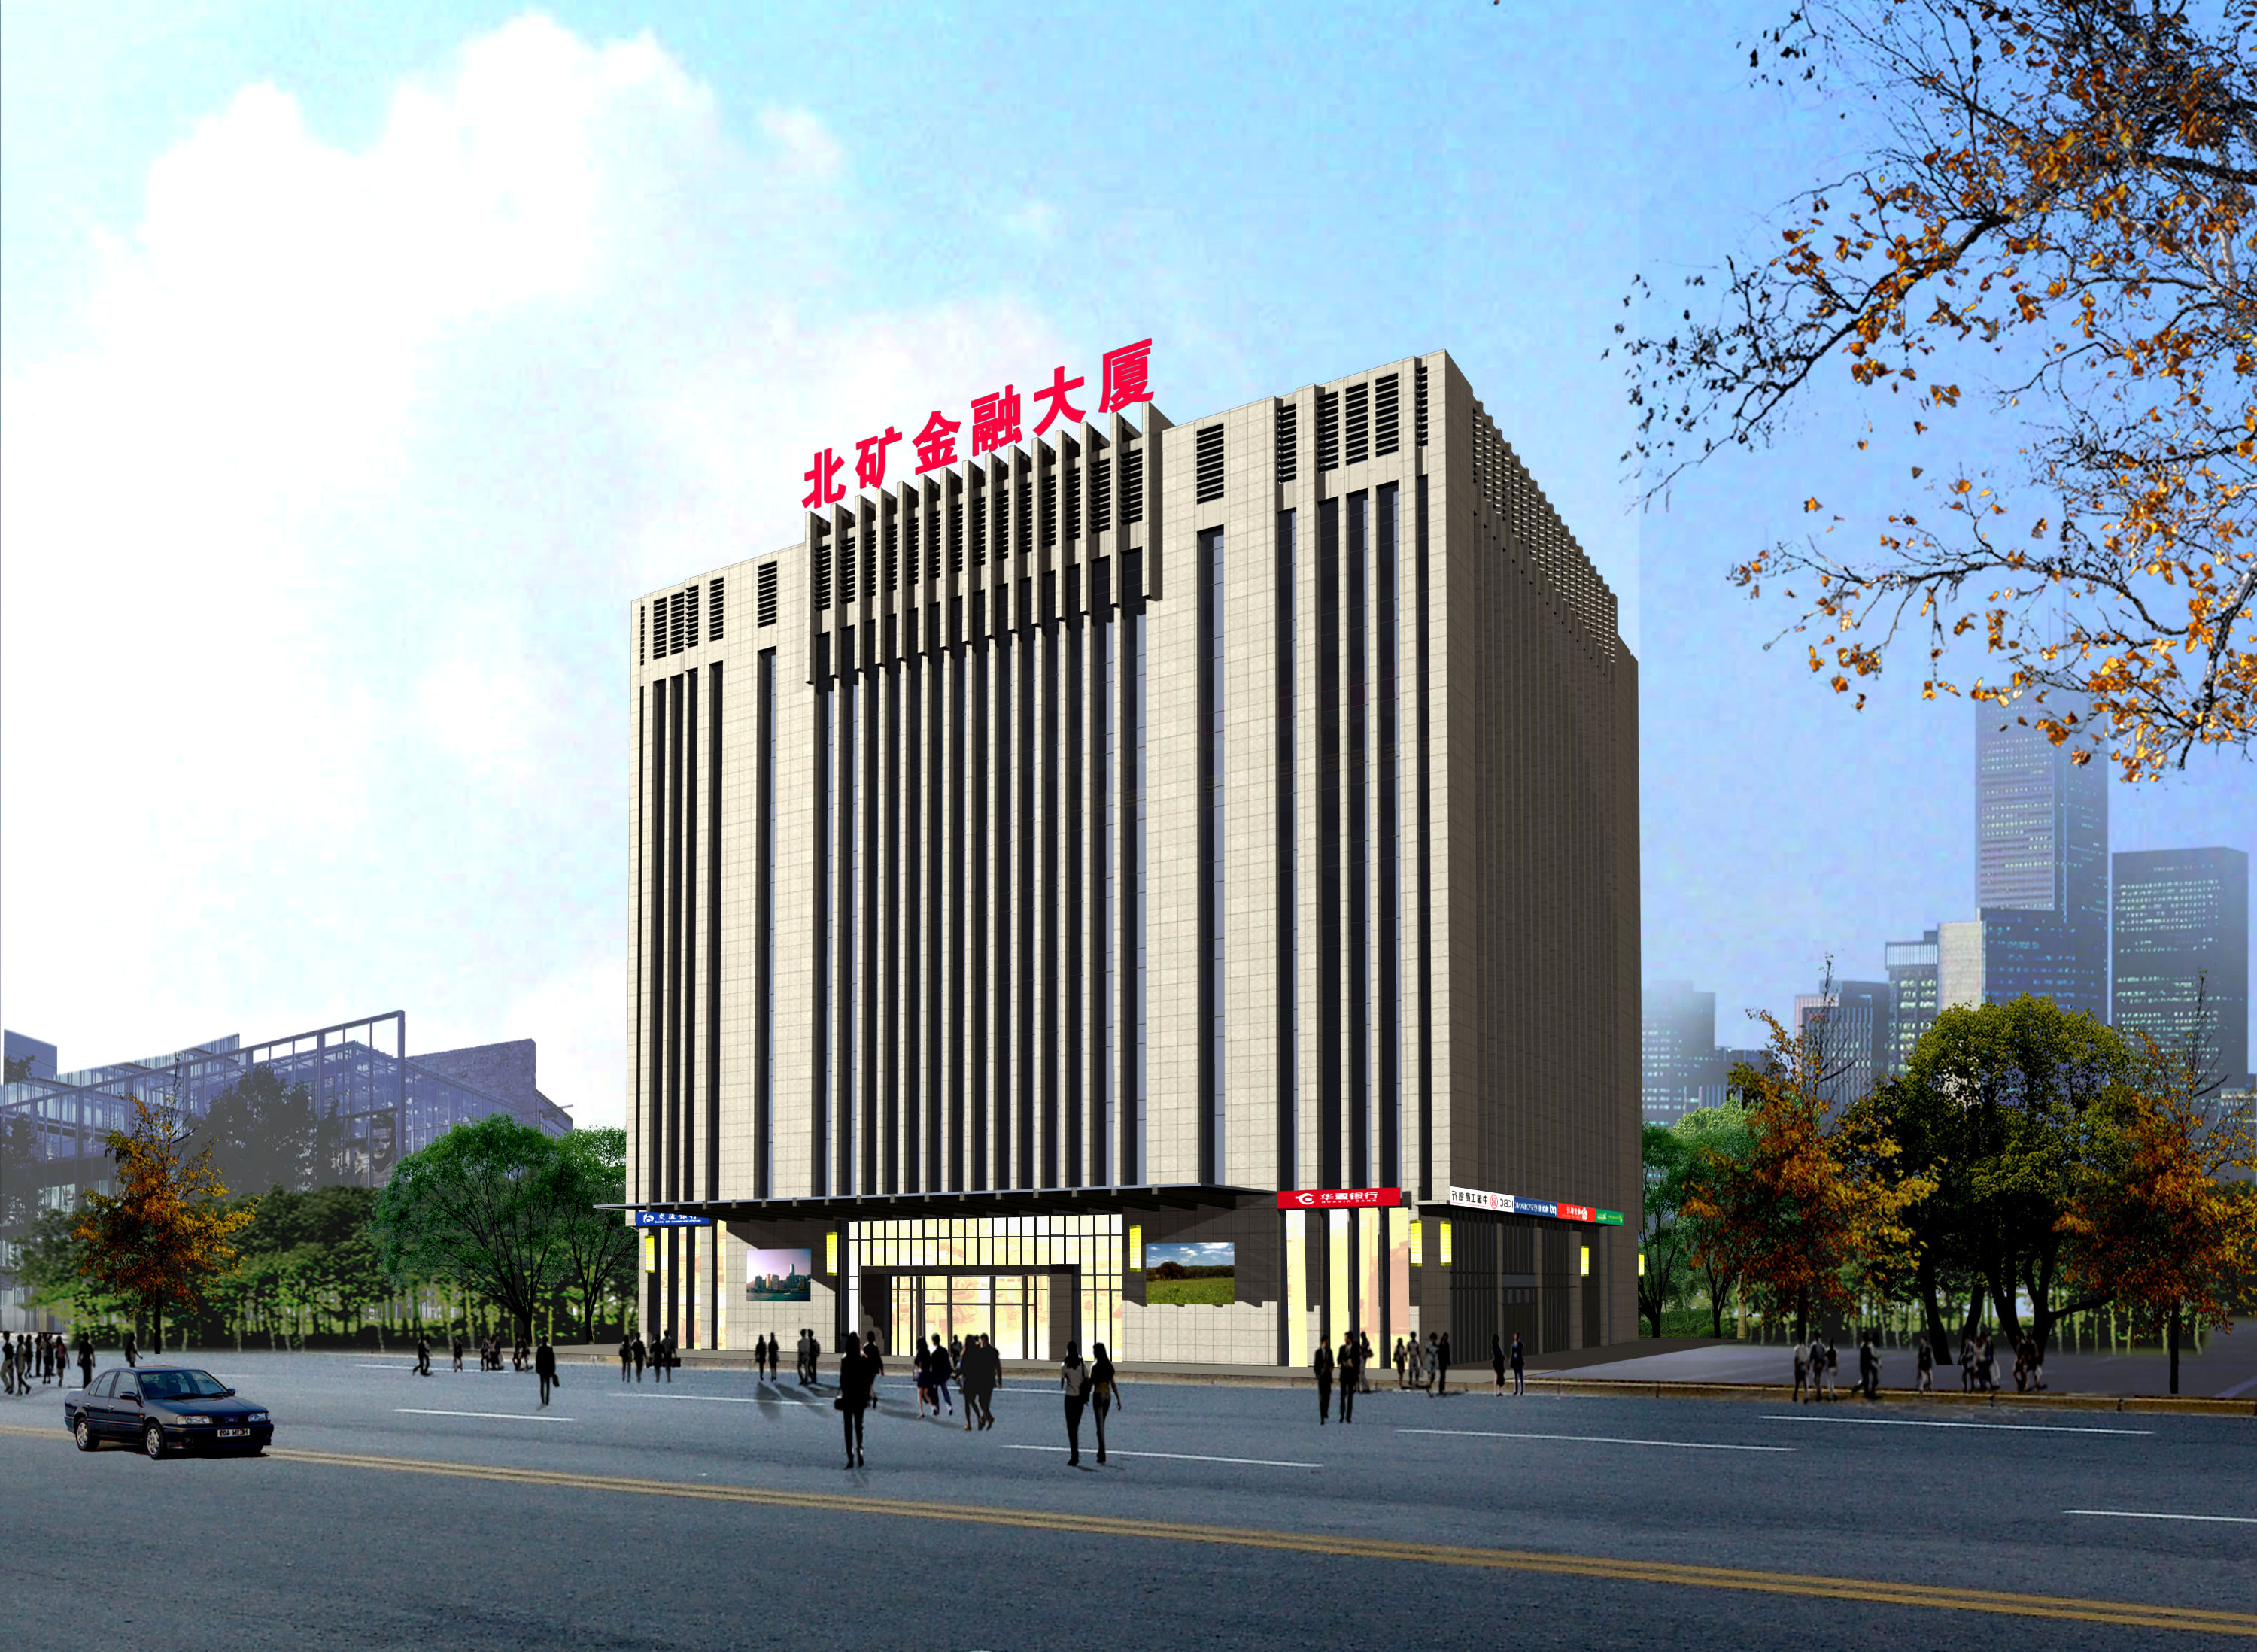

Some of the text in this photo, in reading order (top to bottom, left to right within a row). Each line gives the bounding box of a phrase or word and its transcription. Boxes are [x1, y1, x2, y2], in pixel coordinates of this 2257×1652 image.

[801, 337, 1155, 509] 北矿金融大厦
[1320, 1192, 1378, 1201] 华夏银行
